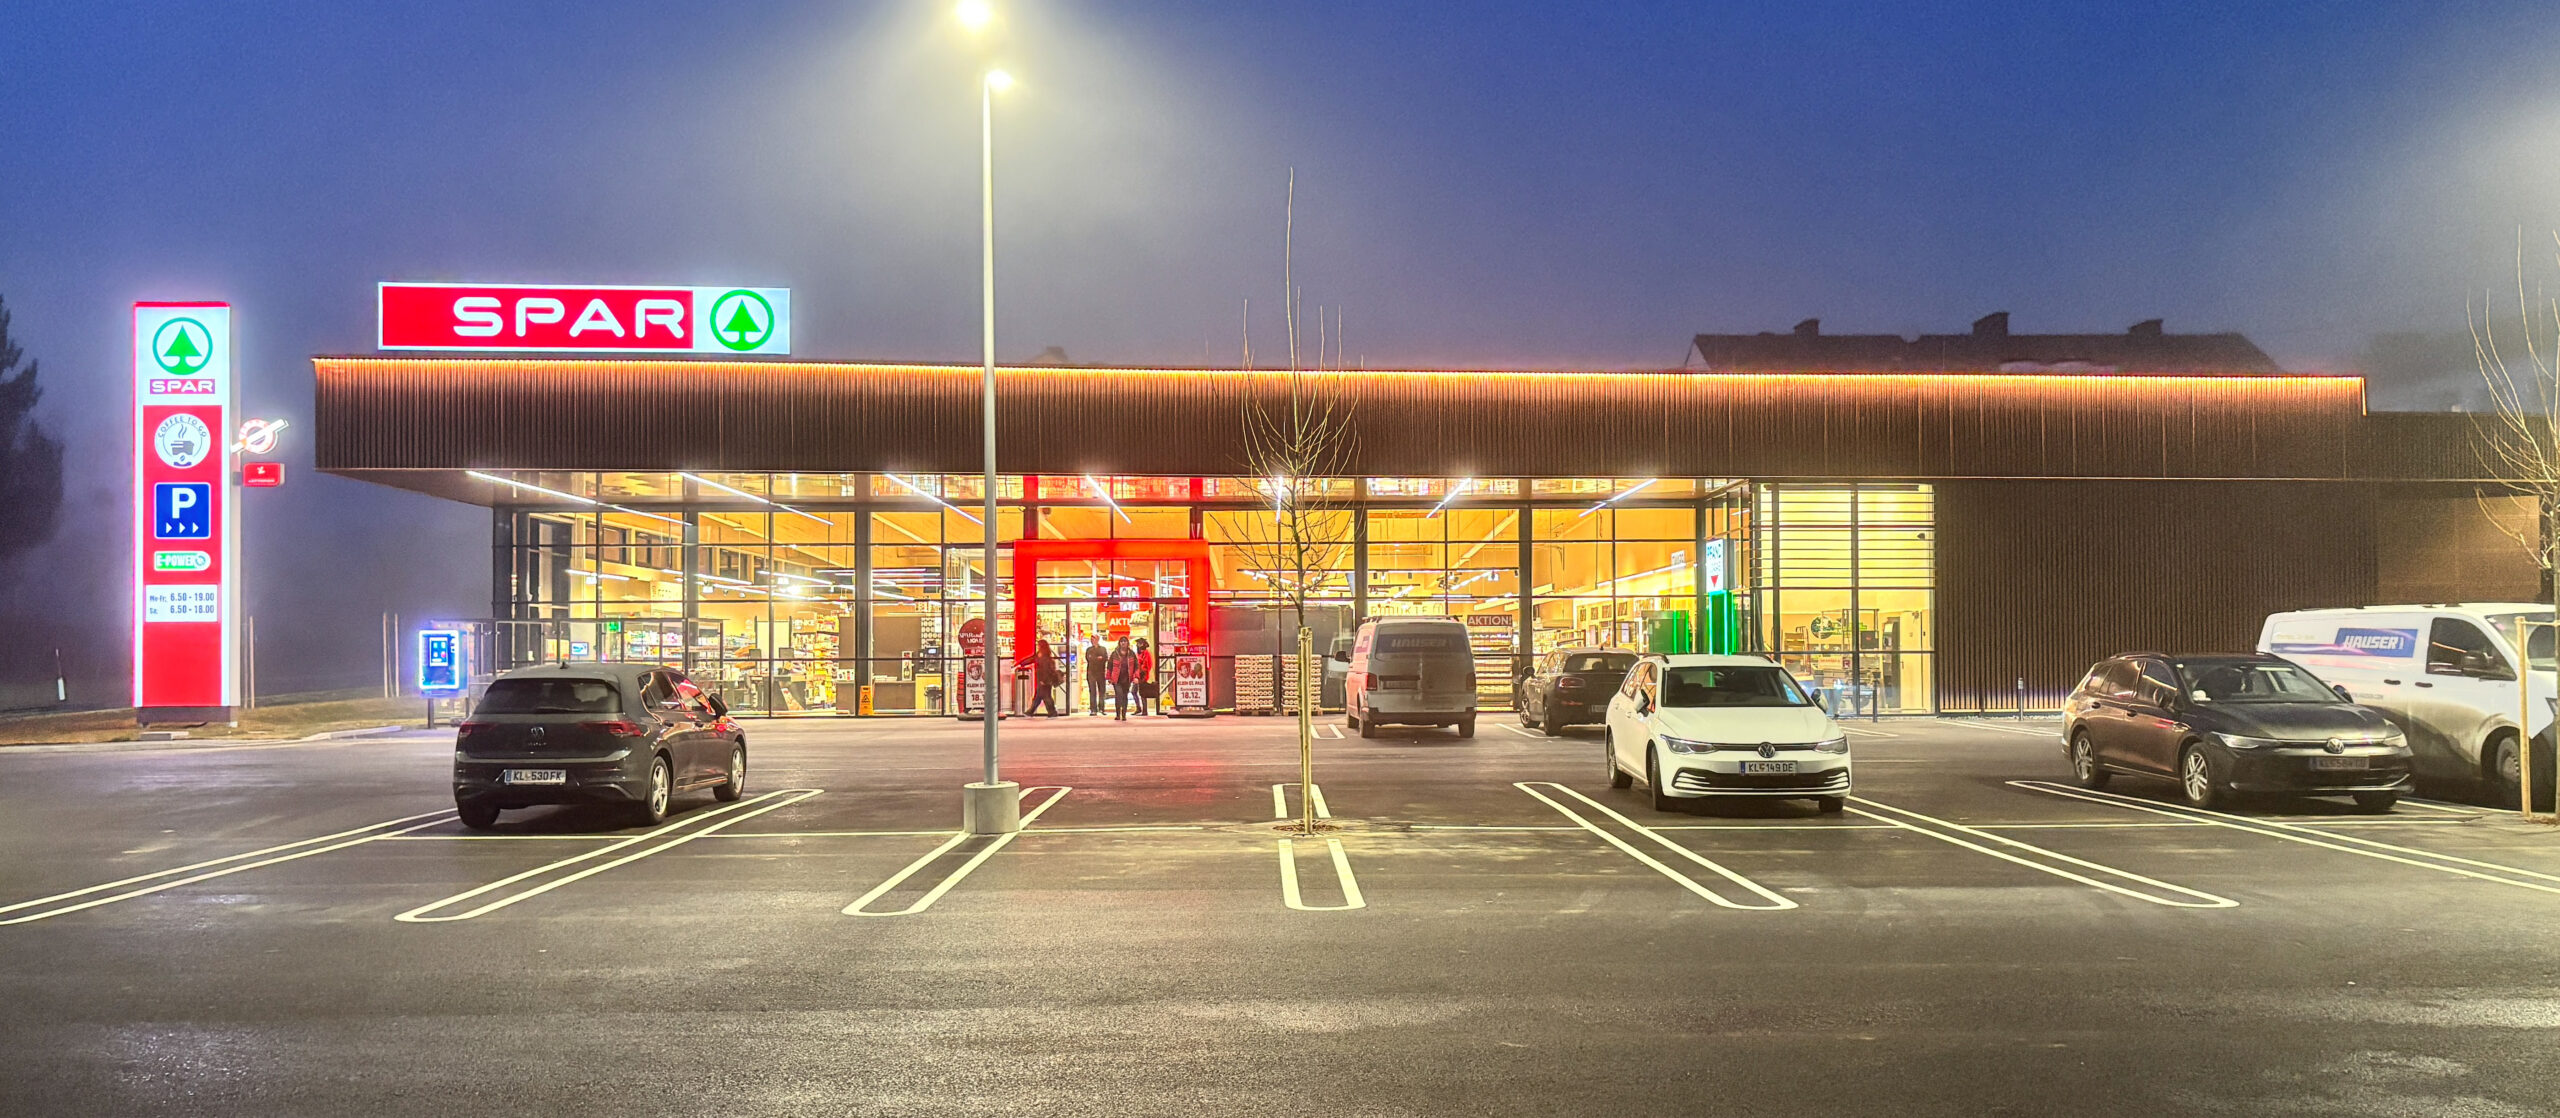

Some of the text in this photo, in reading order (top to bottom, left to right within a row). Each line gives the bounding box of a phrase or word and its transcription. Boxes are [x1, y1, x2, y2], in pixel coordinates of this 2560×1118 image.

[453, 296, 685, 339] SPAR
[151, 380, 214, 393] SPAR
[157, 415, 208, 438] COFFEE TO GO
[171, 487, 198, 518] P
[170, 592, 187, 602] 6.50
[194, 592, 215, 602] 19.00
[170, 604, 187, 614] 6.50
[194, 604, 215, 614] 18.00
[1467, 615, 1513, 626] AKTION!
[2343, 635, 2397, 649] HAUSER
[1748, 763, 1794, 772] KL 149 DE
[513, 770, 562, 781] KL 530 FK
